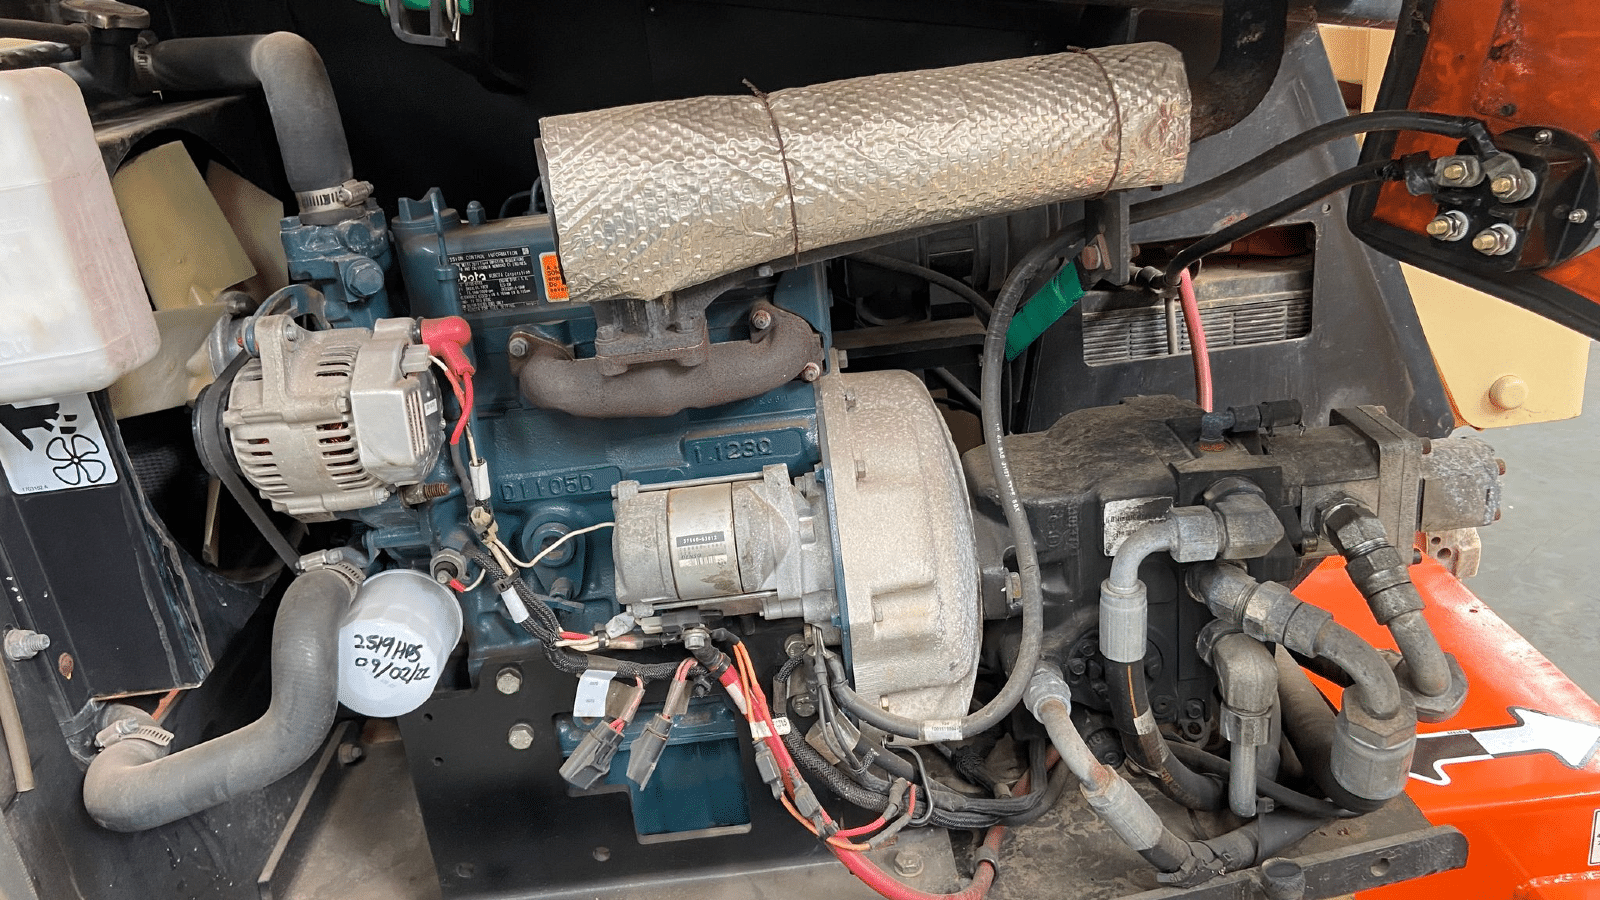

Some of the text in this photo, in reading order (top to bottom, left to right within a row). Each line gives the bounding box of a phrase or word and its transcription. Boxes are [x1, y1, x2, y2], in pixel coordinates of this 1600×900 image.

[466, 253, 486, 261] CONTROL
[488, 250, 518, 258] INFORMATION
[505, 269, 531, 278] Corporation
